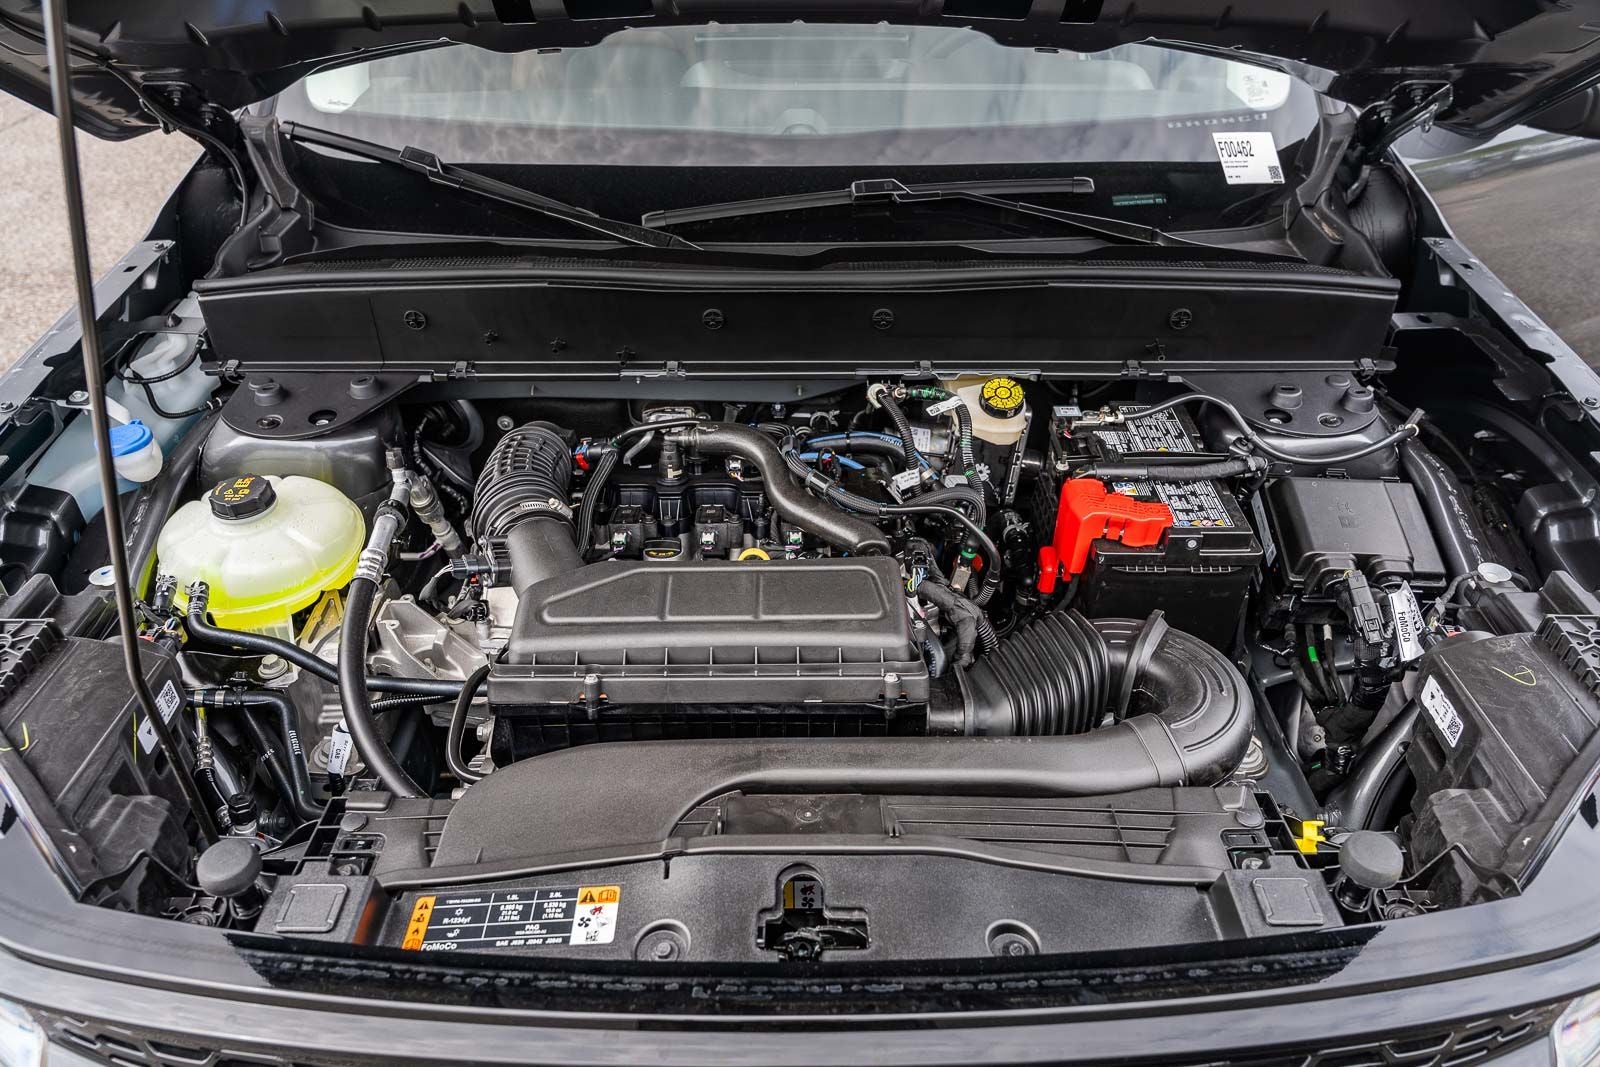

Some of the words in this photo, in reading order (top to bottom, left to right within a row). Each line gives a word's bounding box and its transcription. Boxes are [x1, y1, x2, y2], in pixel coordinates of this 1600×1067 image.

[1218, 140, 1254, 157] F00462
[1398, 612, 1410, 642] FoMoCo
[421, 942, 457, 952] FoMoCo
